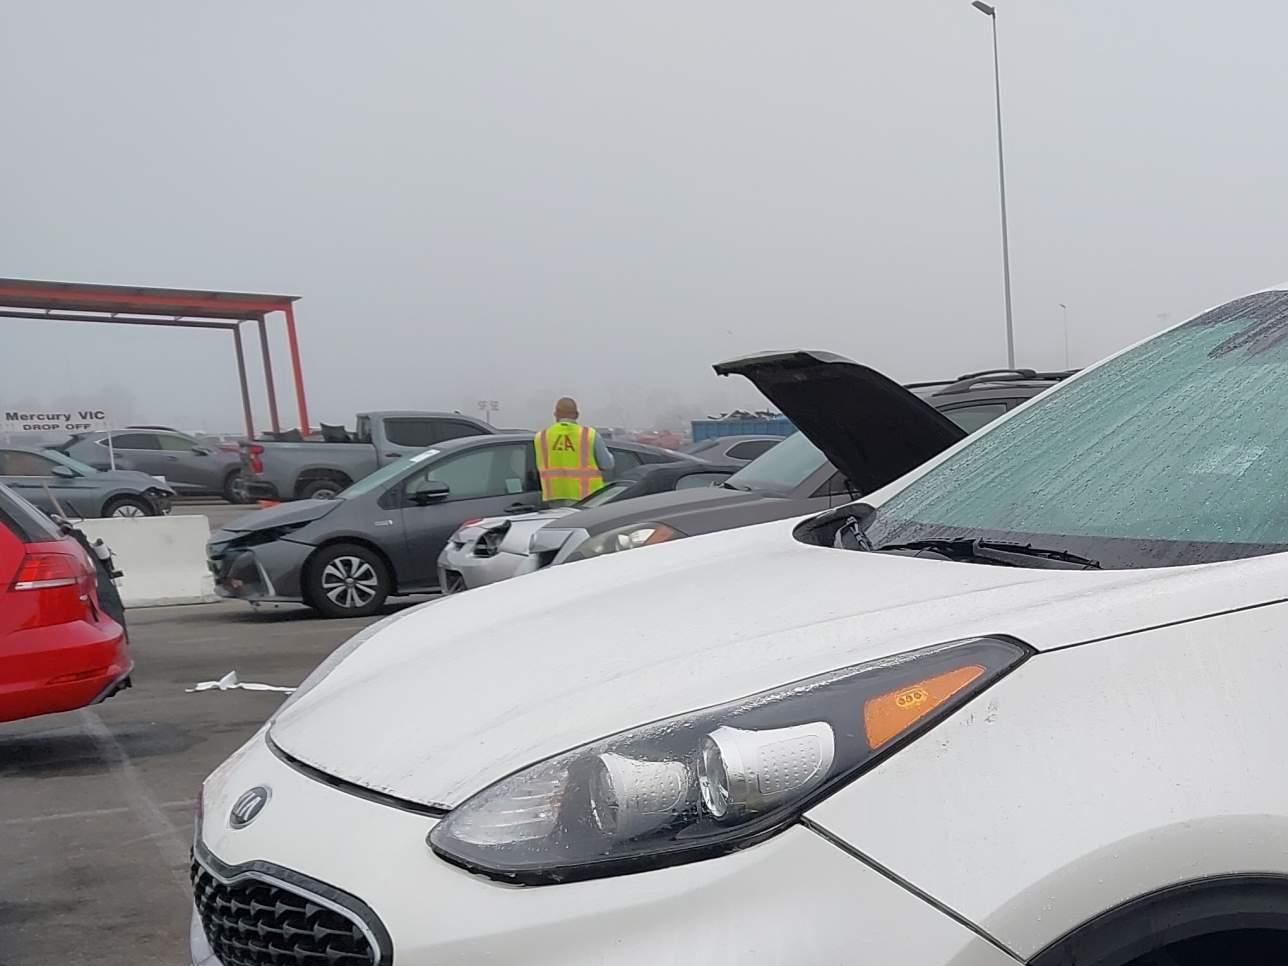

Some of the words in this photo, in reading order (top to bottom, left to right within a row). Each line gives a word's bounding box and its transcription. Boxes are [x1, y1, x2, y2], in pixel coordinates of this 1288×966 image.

[5, 412, 72, 422] Mercury
[78, 411, 105, 421] VIC
[23, 423, 60, 431] DROP
[65, 423, 91, 431] OFF
